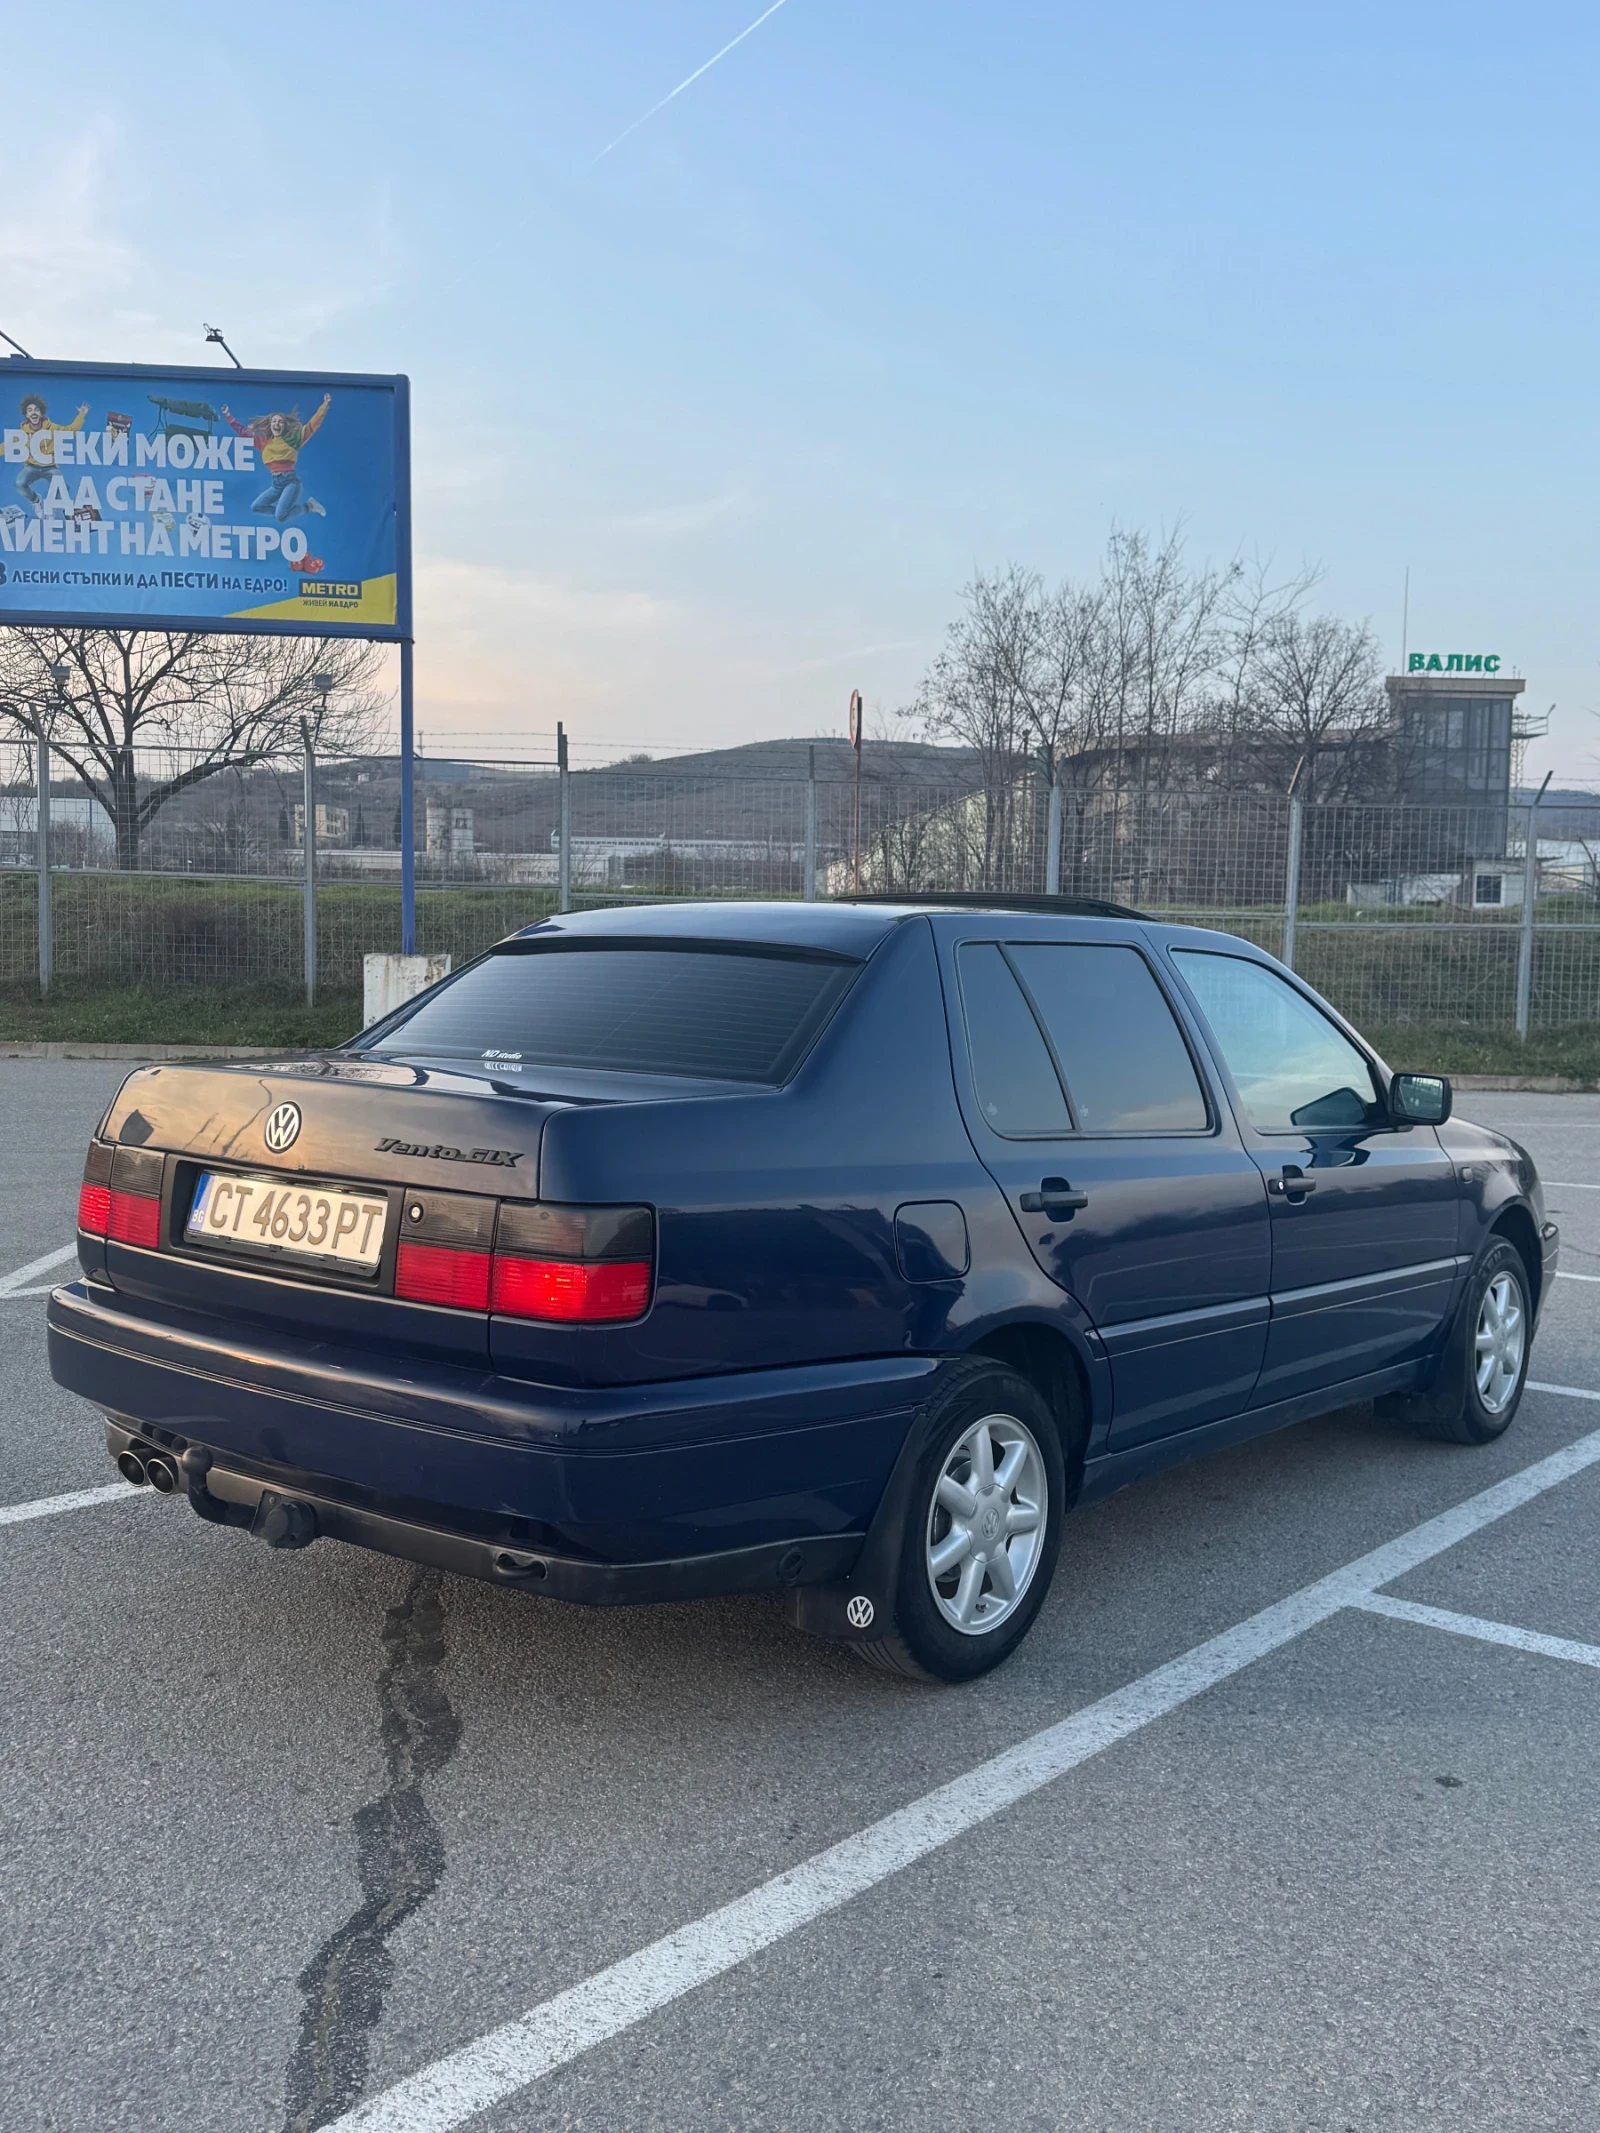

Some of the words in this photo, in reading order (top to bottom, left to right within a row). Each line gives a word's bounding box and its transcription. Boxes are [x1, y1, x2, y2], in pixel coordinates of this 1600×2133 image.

[4, 429, 129, 466] ВСЕКИ
[135, 433, 255, 471] МОЖЕ
[43, 475, 102, 516] ДА
[106, 476, 224, 514] СТАНЕ
[120, 521, 174, 556] НА
[179, 523, 308, 562] МЕТРО
[12, 570, 60, 584] ЛЕСНИ
[62, 571, 121, 586] СТЪПКИ
[124, 573, 134, 586] И
[136, 574, 158, 589] ДА
[161, 571, 218, 589] ПЕСТИ
[222, 577, 242, 590] НА
[244, 578, 288, 593] ЕДРО!
[302, 582, 358, 596] METRO
[1408, 653, 1501, 672] ВАЛИС
[374, 1137, 461, 1161] Vento
[465, 1147, 525, 1167] GLX
[191, 1208, 205, 1223] BG
[253, 1190, 331, 1245] 4633
